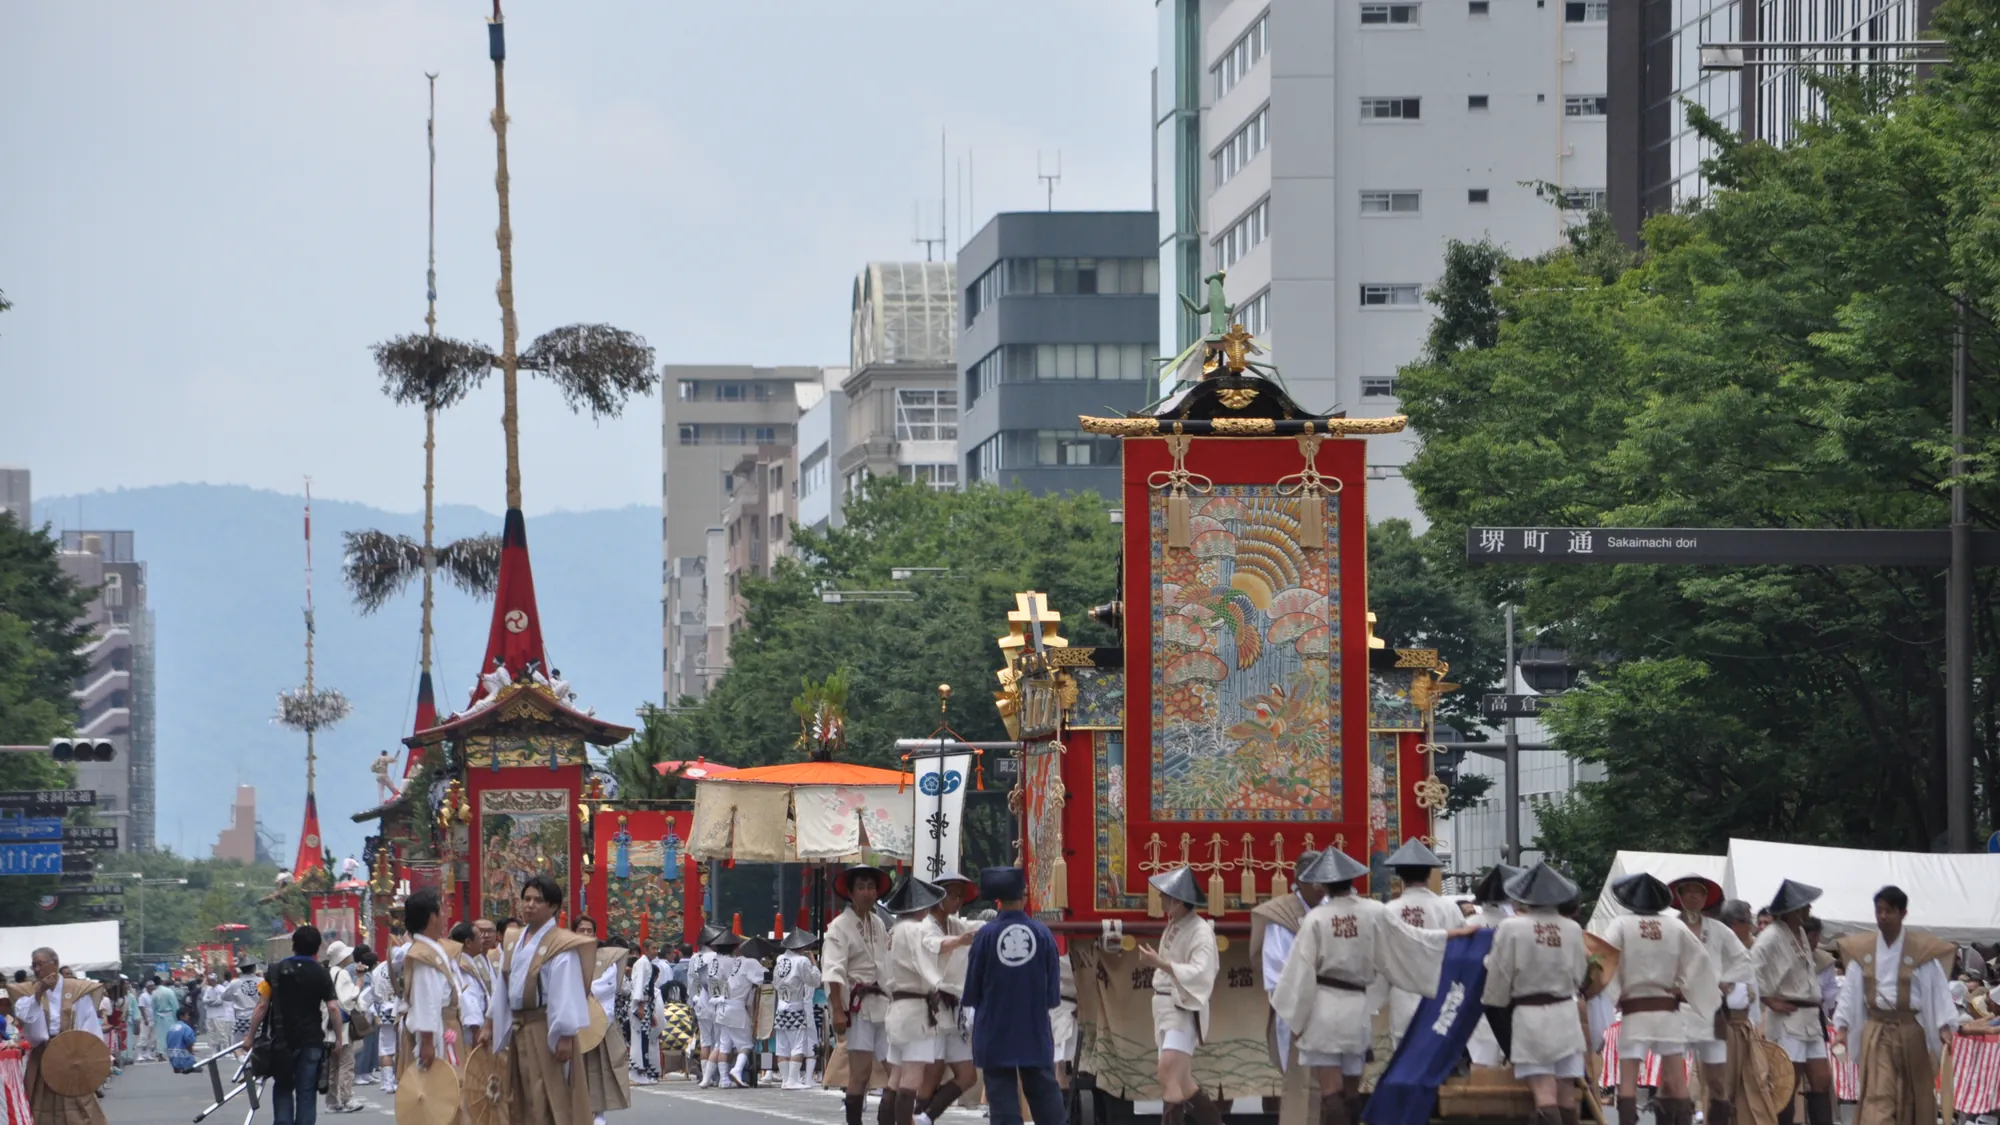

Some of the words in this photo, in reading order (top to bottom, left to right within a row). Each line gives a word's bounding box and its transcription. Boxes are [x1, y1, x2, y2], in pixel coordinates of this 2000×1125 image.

[1479, 529, 1594, 554] 堺町通
[1607, 537, 1672, 548] Sakaimachi
[1675, 537, 1697, 548] dori
[1000, 760, 1018, 773] 間之
